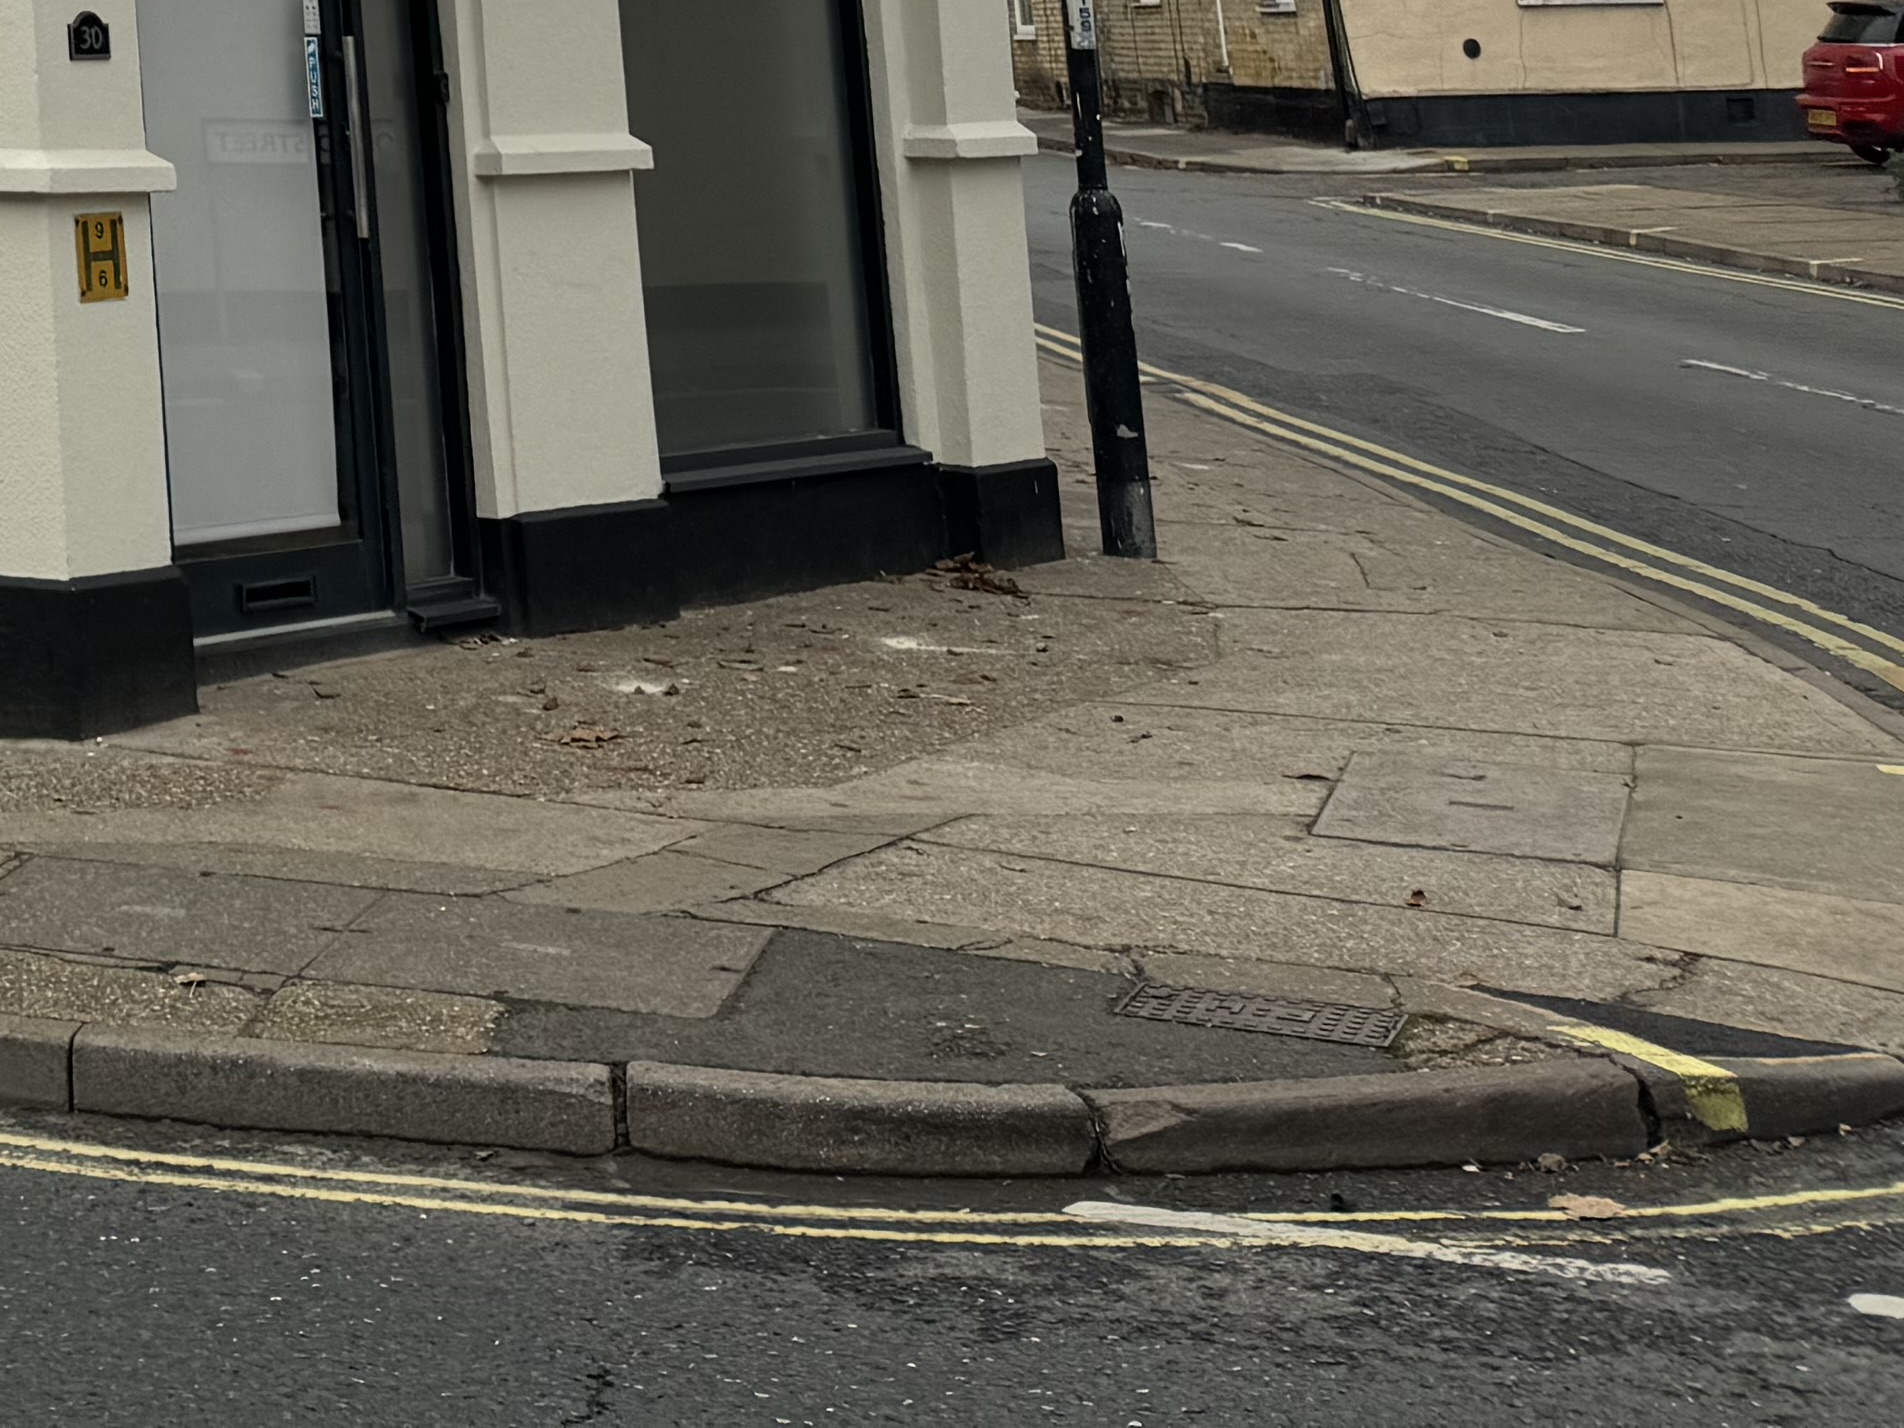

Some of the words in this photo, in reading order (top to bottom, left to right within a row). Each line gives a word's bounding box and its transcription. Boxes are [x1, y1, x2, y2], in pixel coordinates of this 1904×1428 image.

[79, 25, 102, 50] 30
[308, 55, 320, 110] PUSH
[94, 220, 105, 240] 9
[98, 269, 108, 288] 6
